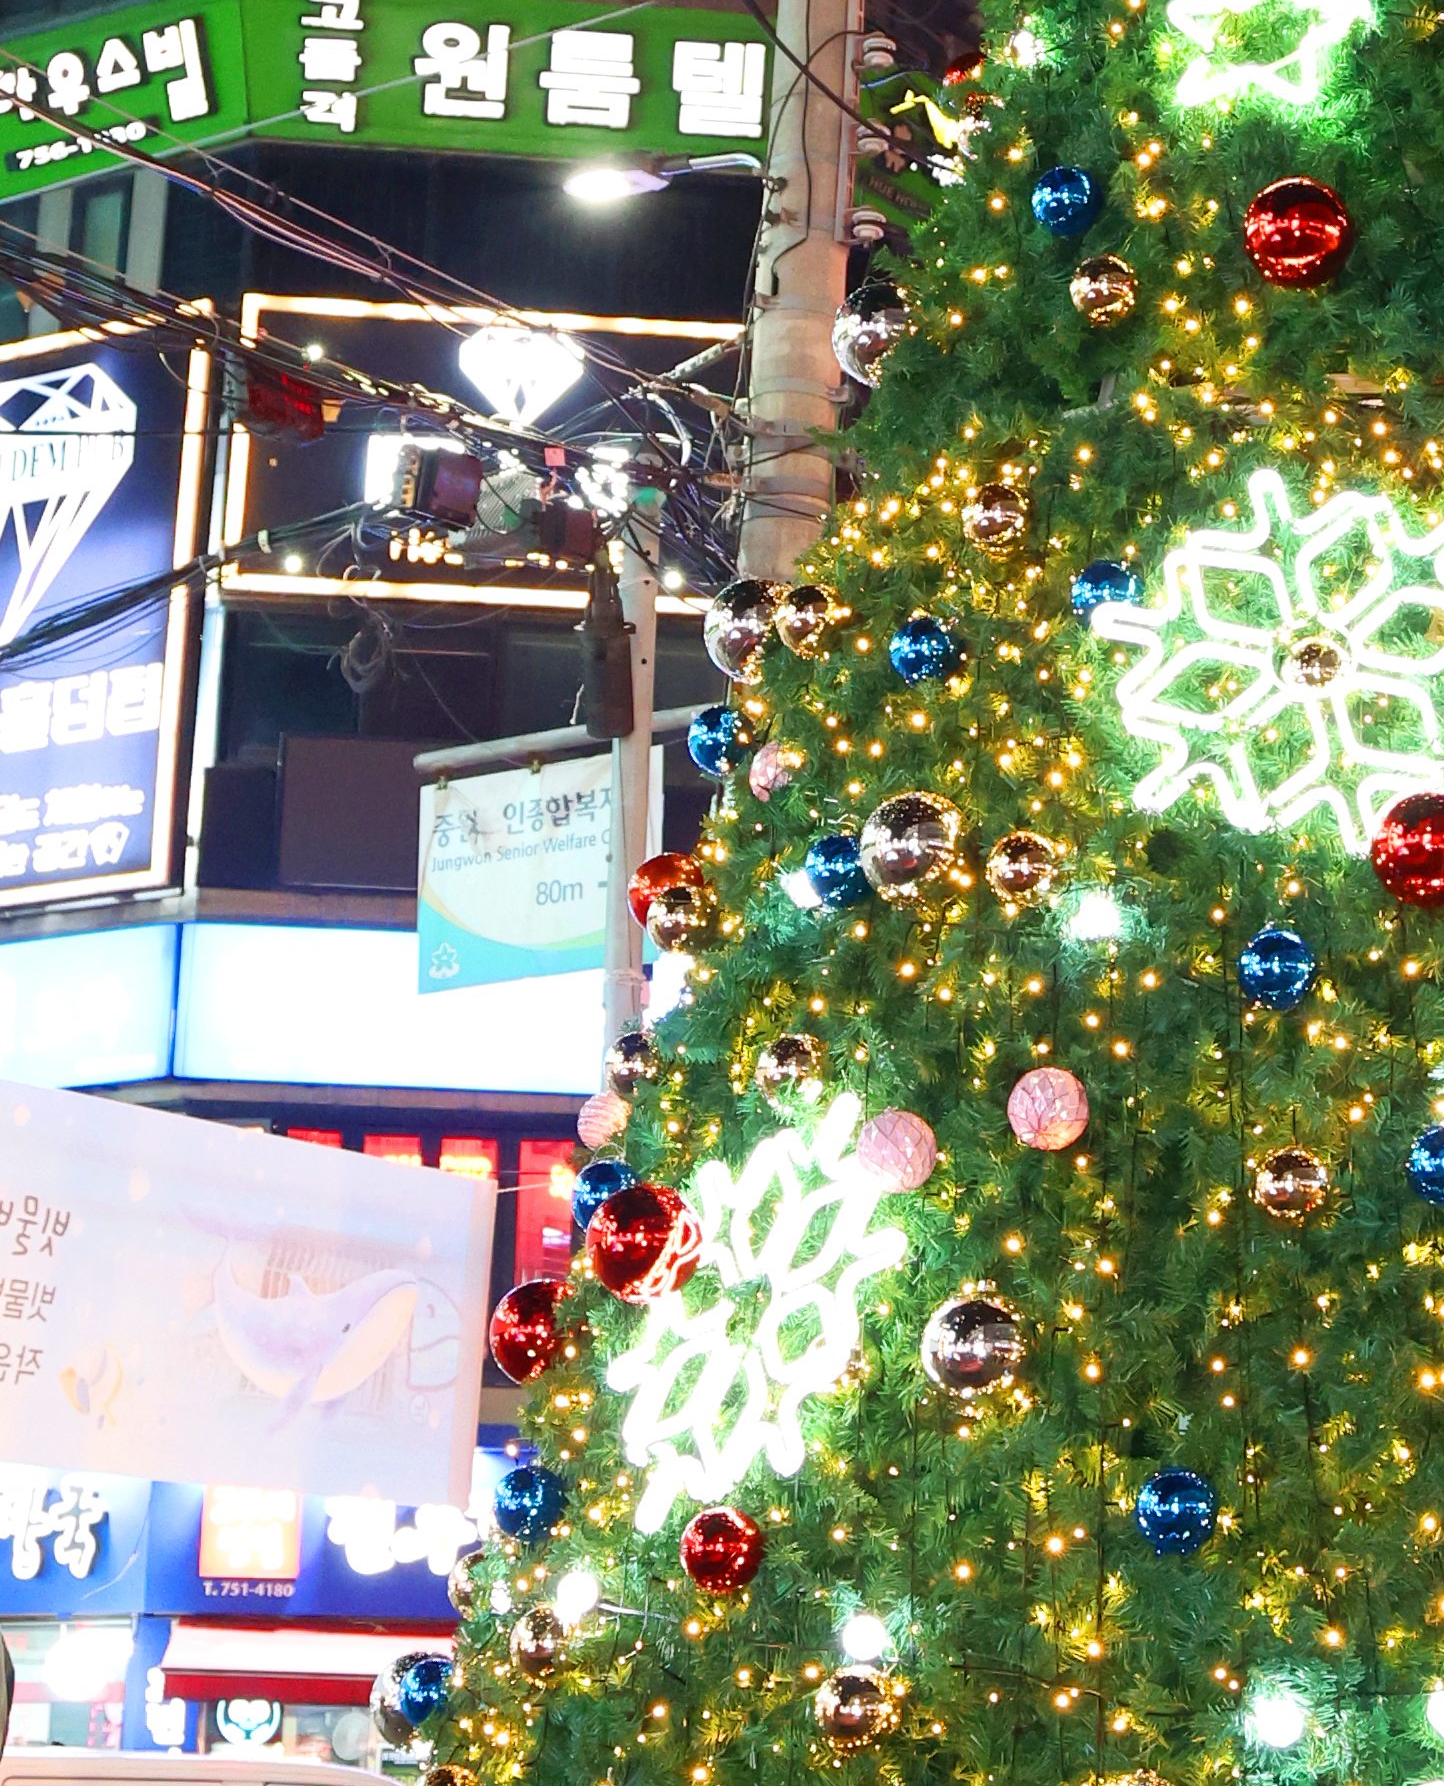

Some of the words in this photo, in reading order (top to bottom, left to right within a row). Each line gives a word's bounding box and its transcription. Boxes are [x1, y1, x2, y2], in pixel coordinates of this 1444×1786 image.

[414, 21, 766, 138] 원룸텔
[432, 851, 492, 873] Jungwon
[496, 842, 540, 862] Senior
[543, 832, 596, 853] Welfare
[536, 879, 583, 906] 80m
[221, 1582, 294, 1598] 751-4180
